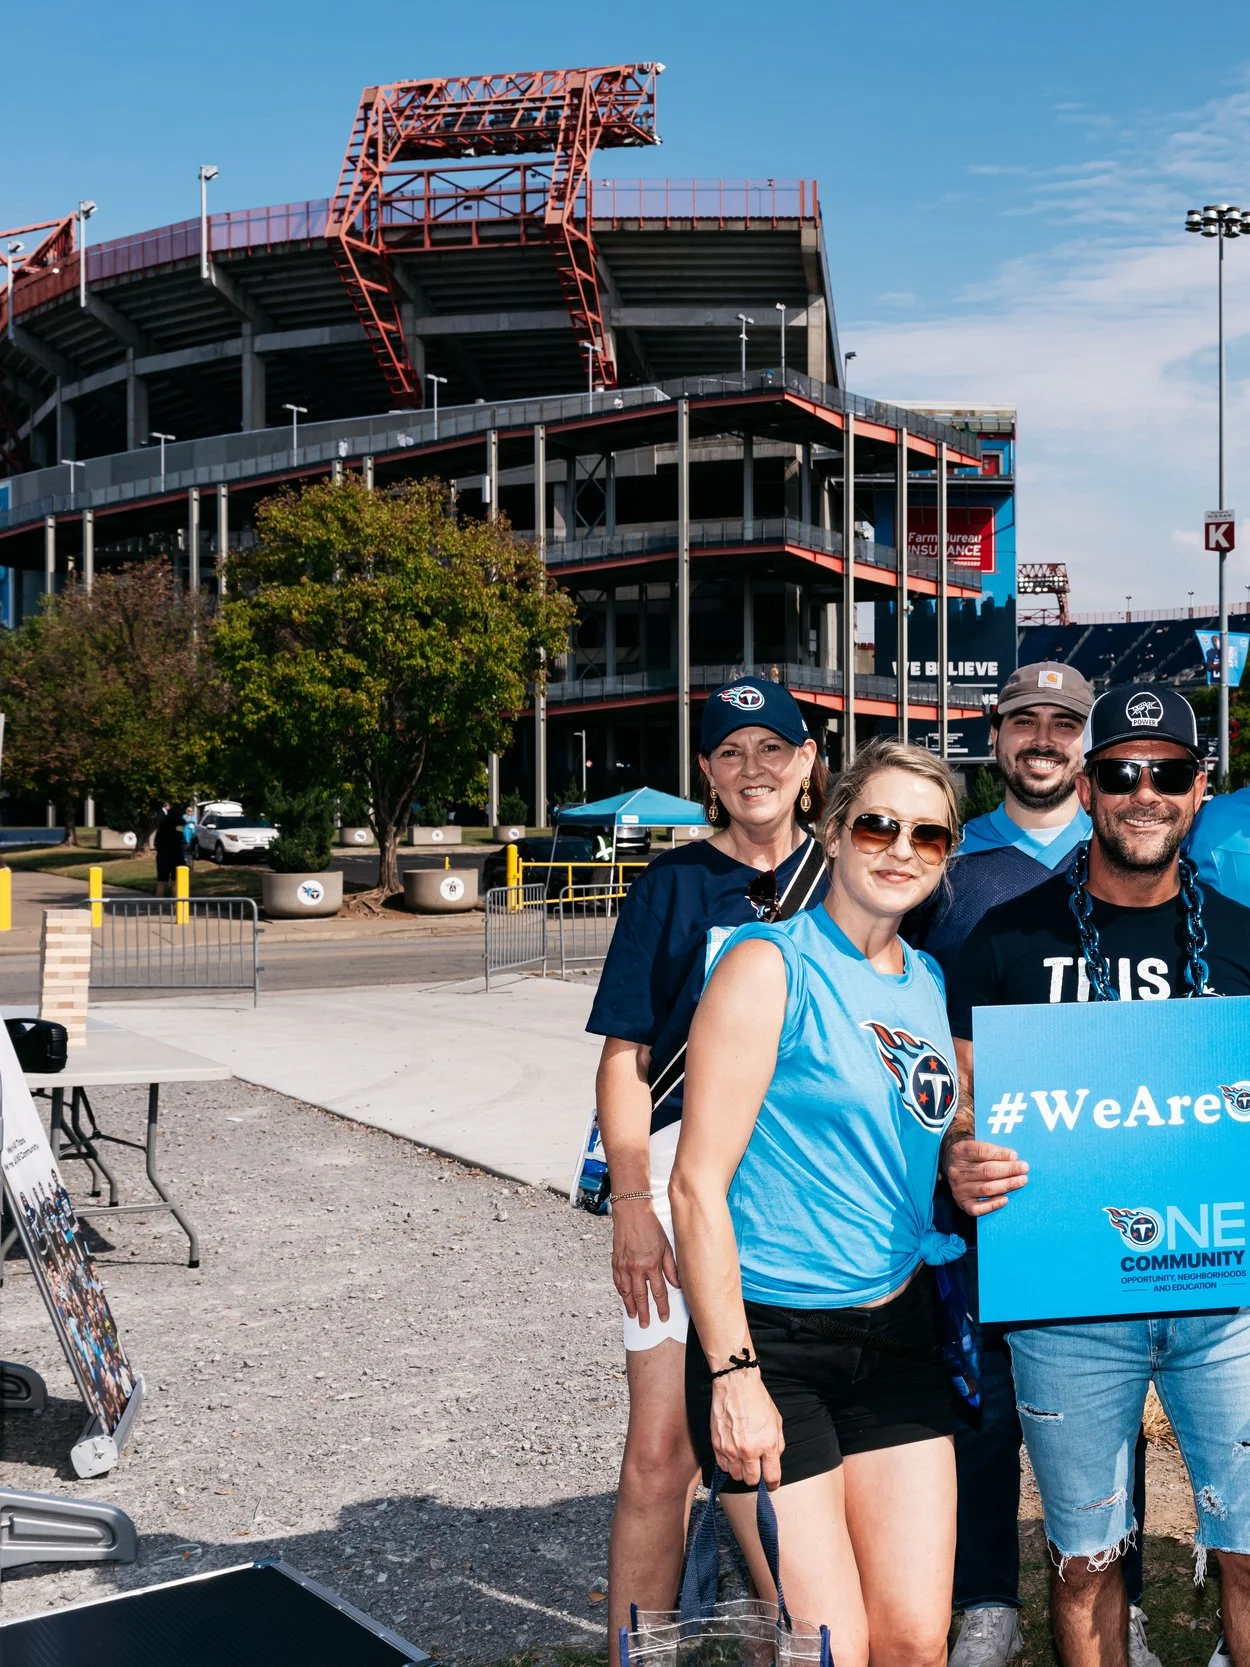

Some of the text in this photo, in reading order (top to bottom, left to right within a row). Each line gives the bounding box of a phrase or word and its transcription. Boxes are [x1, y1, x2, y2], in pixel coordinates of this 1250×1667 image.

[908, 532, 938, 542] Farm
[1209, 523, 1230, 548] K
[908, 544, 982, 556] INSUANCE
[925, 661, 998, 676] BLIEVE
[1133, 718, 1156, 726] POWER
[1119, 1201, 1246, 1253] ONE
[1120, 1250, 1246, 1272] COMMUNITY
[1121, 1269, 1247, 1285] OPPORTUNITY, NEIGHBORHOODS
[1153, 1281, 1217, 1292] AND EDUCATION
